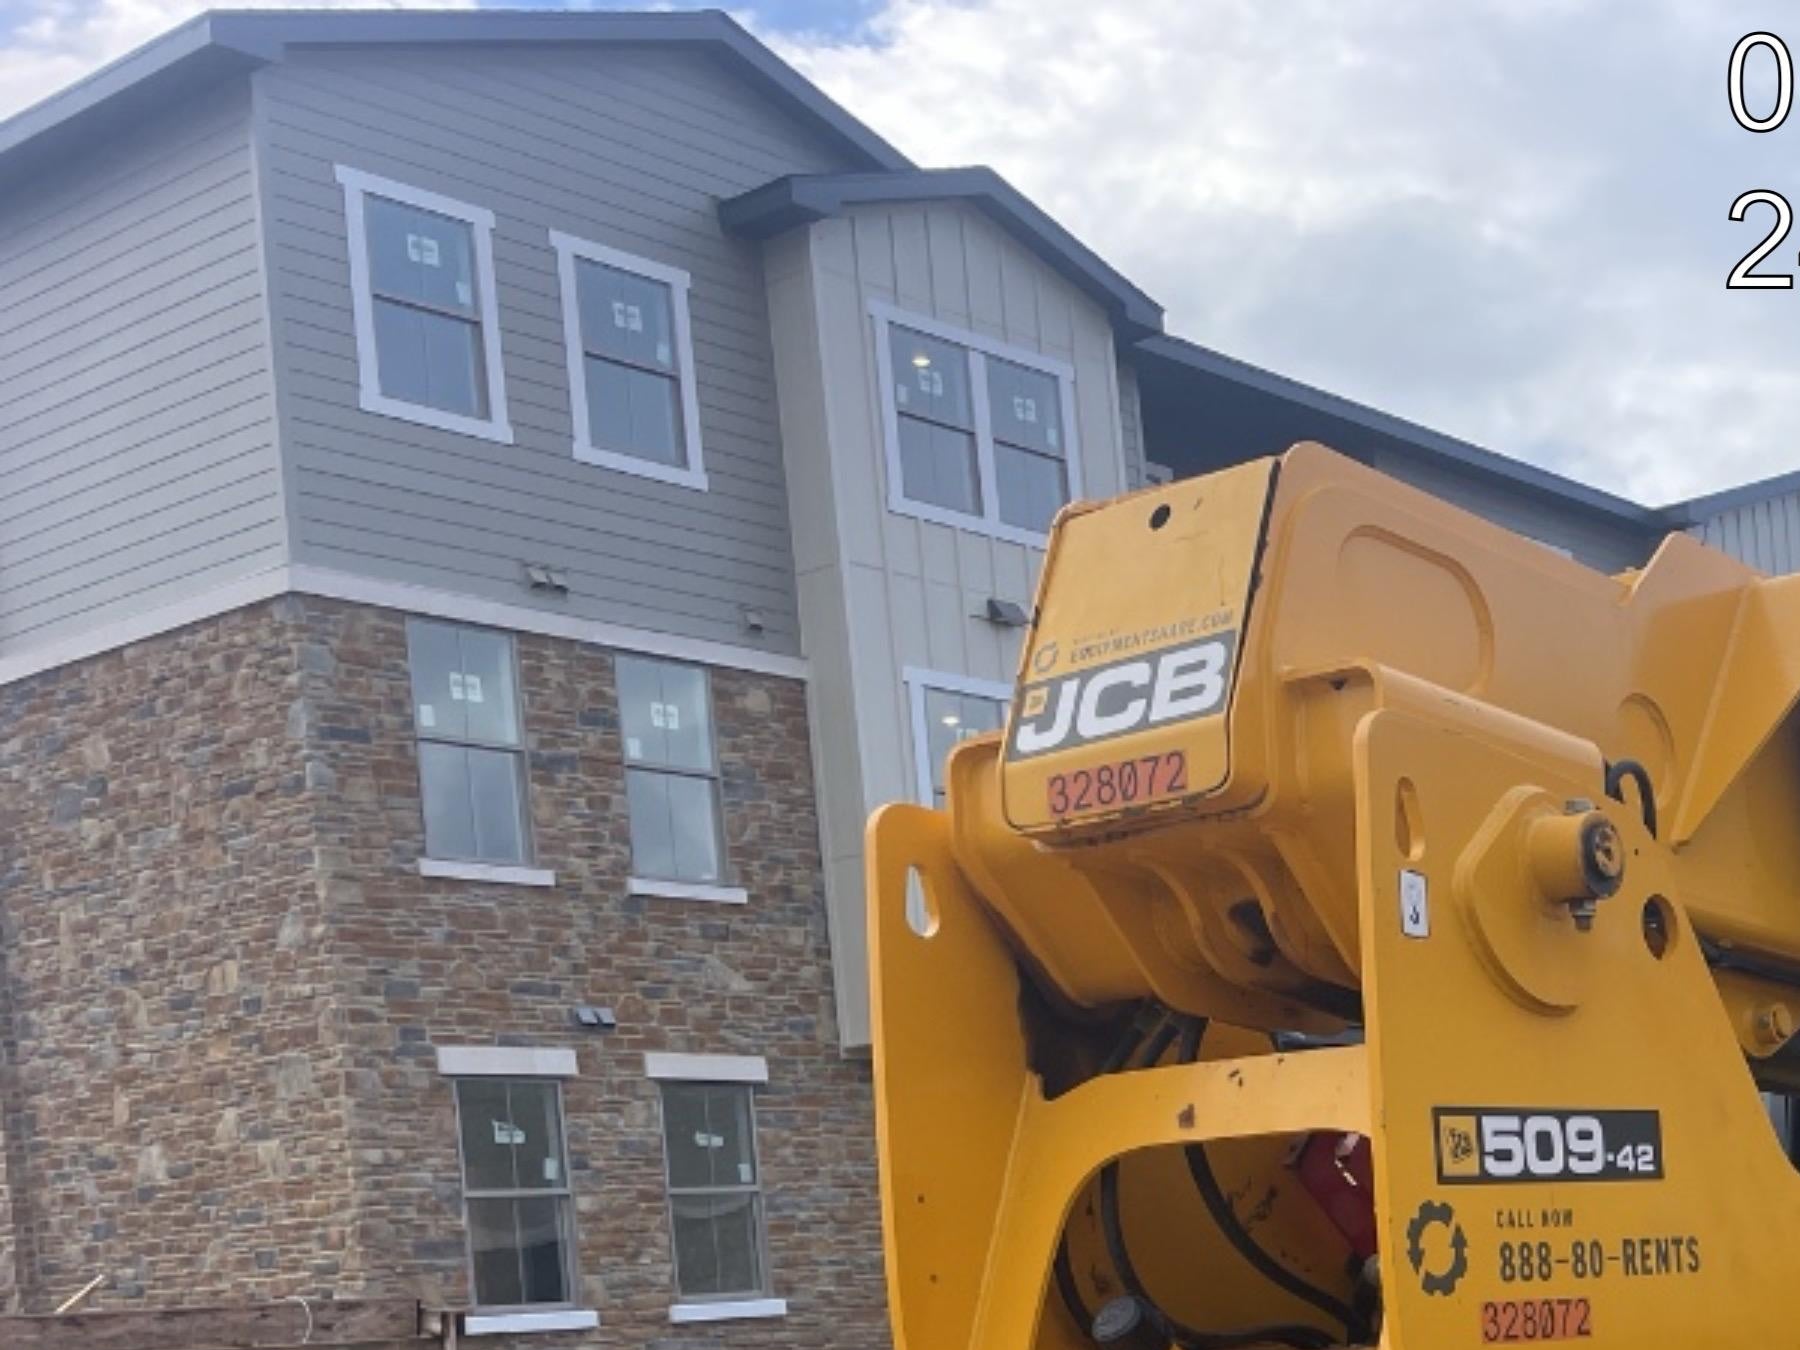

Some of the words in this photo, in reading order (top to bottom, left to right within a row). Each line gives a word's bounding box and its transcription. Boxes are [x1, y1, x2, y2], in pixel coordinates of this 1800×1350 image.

[1015, 640, 1229, 755] JCB
[1049, 750, 1188, 815] 328072
[1496, 1209, 1534, 1229] CALL
[1541, 1208, 1573, 1228] NOW
[1499, 1236, 1700, 1283] 888-80-RENTS
[1482, 1298, 1592, 1343] 328072
